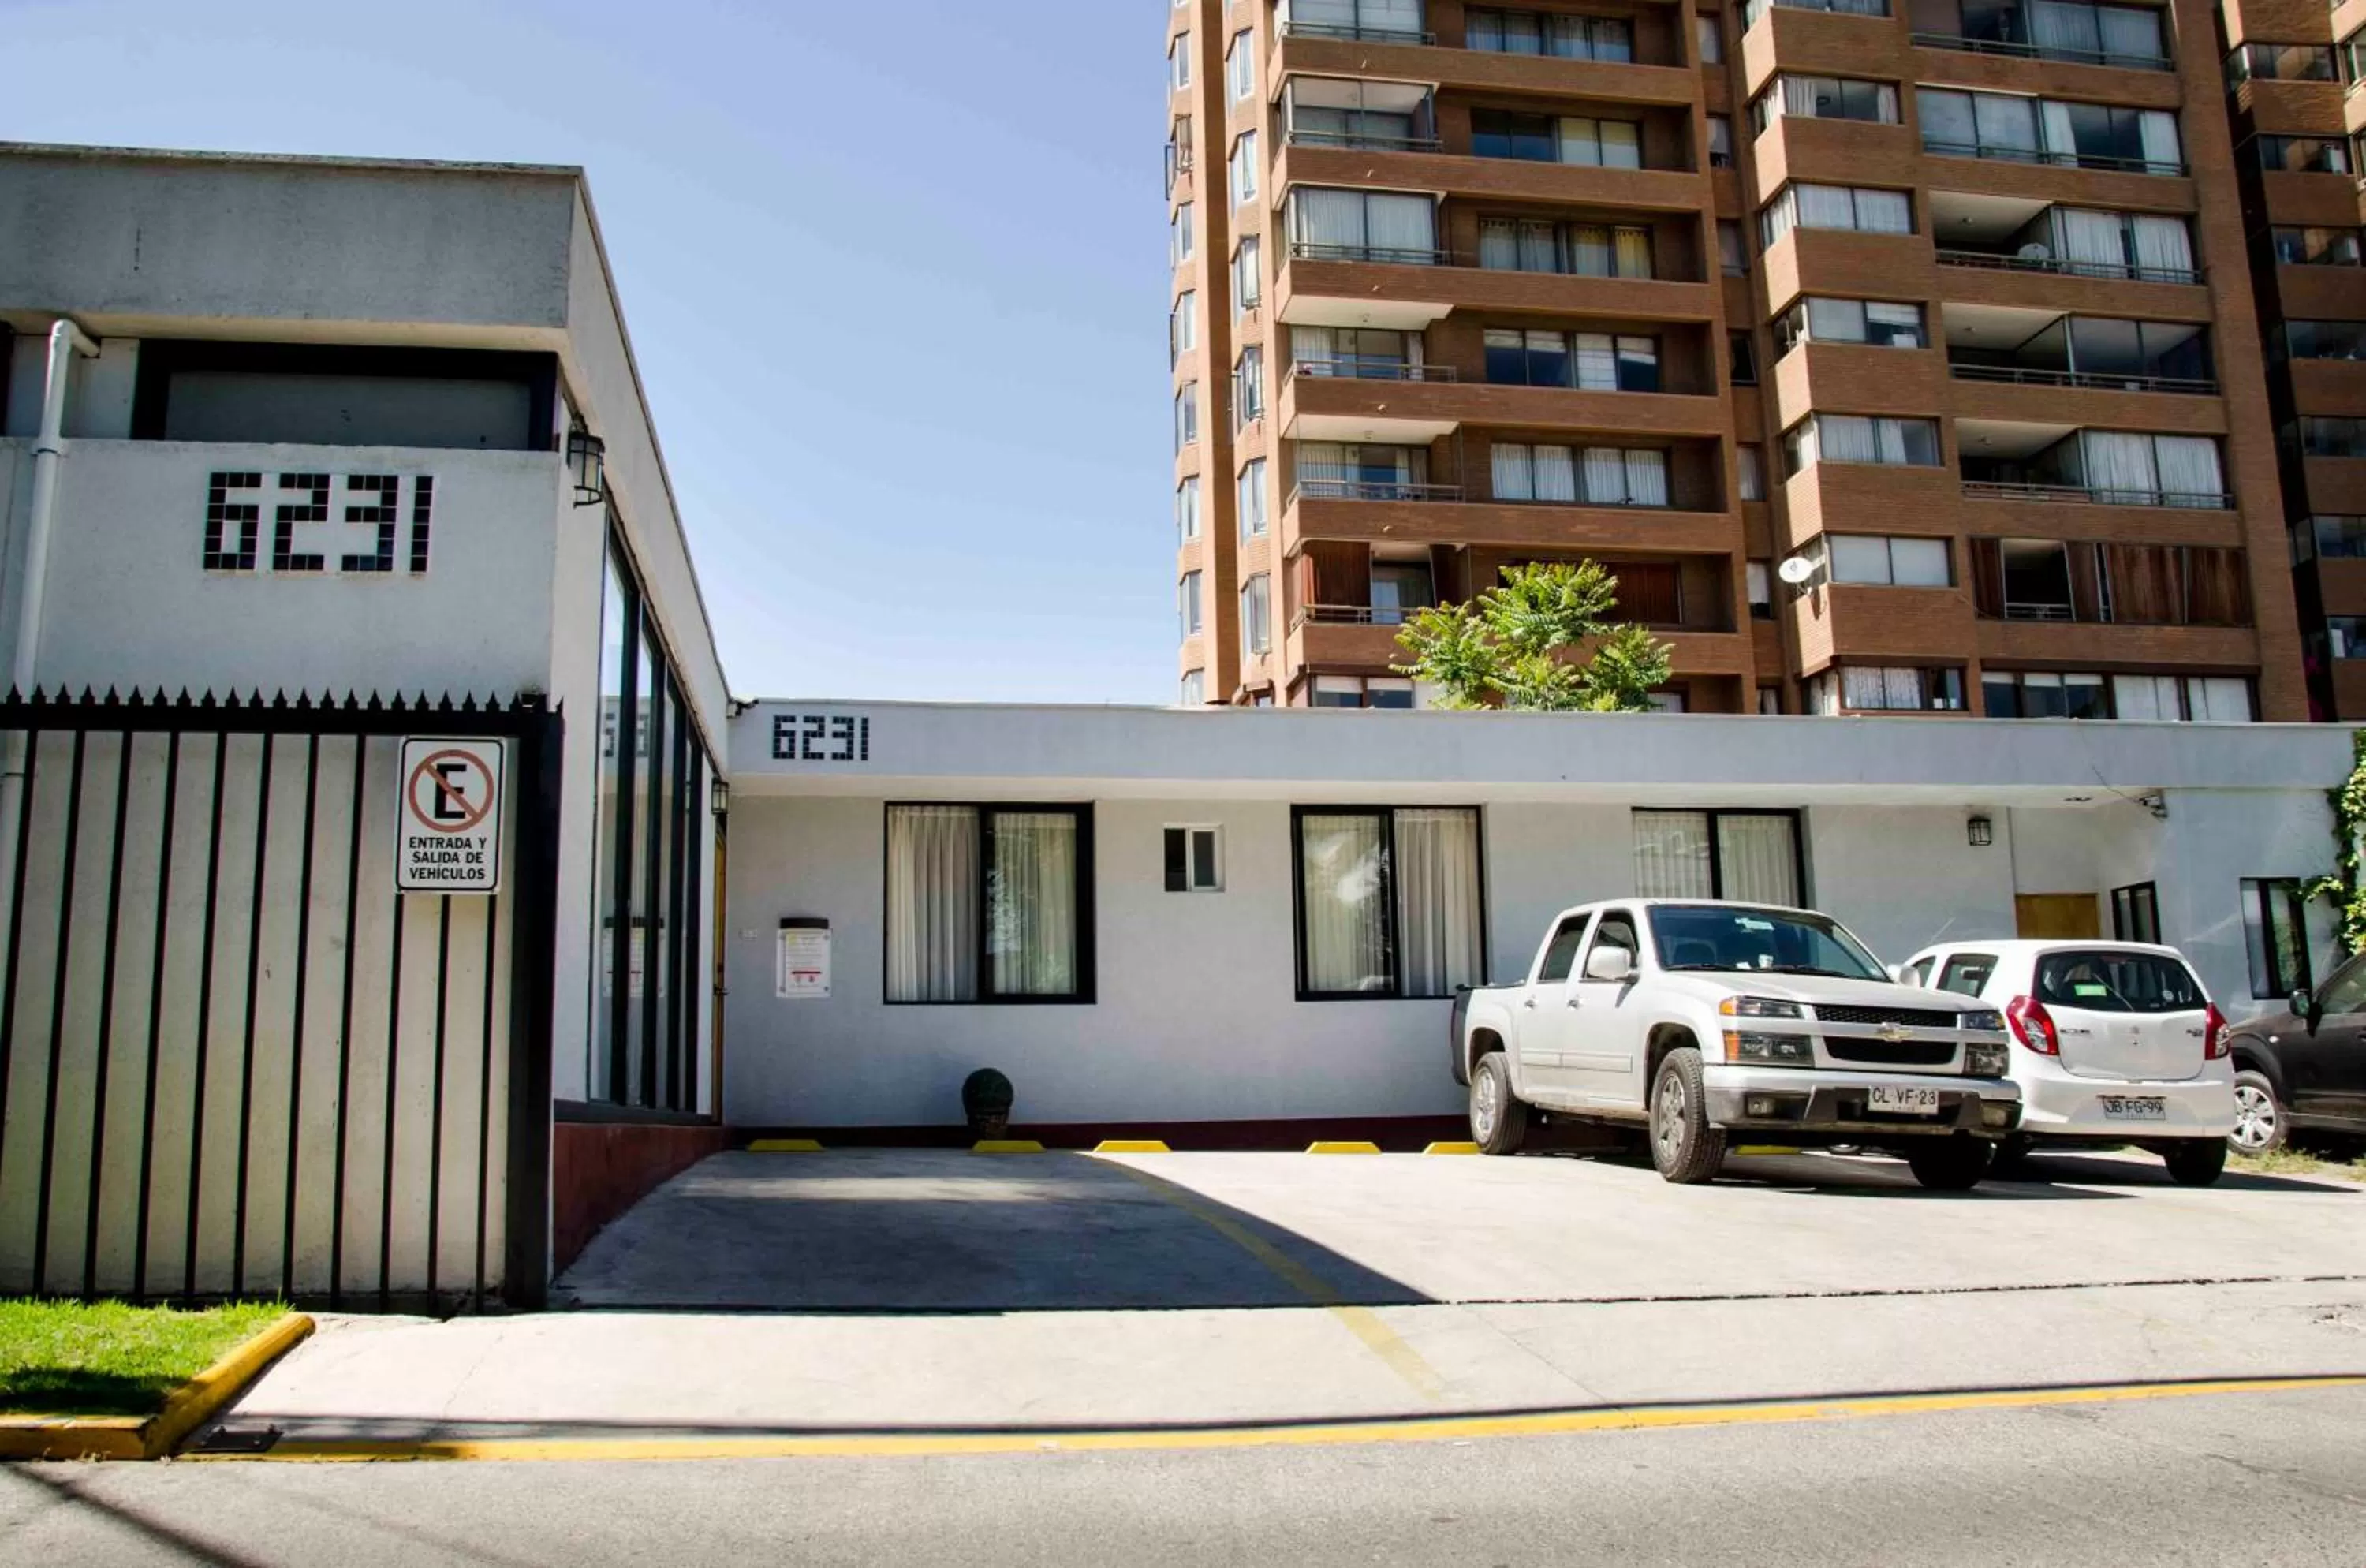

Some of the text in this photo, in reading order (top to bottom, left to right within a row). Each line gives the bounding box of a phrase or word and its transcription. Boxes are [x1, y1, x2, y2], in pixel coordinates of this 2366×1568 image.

[203, 472, 433, 572] 6231
[774, 715, 868, 760] 6231
[435, 763, 467, 819] E
[409, 837, 487, 849] ENTRADA Y
[409, 865, 485, 879] VEHÍCULOS
[412, 852, 483, 864] SALIDA DE
